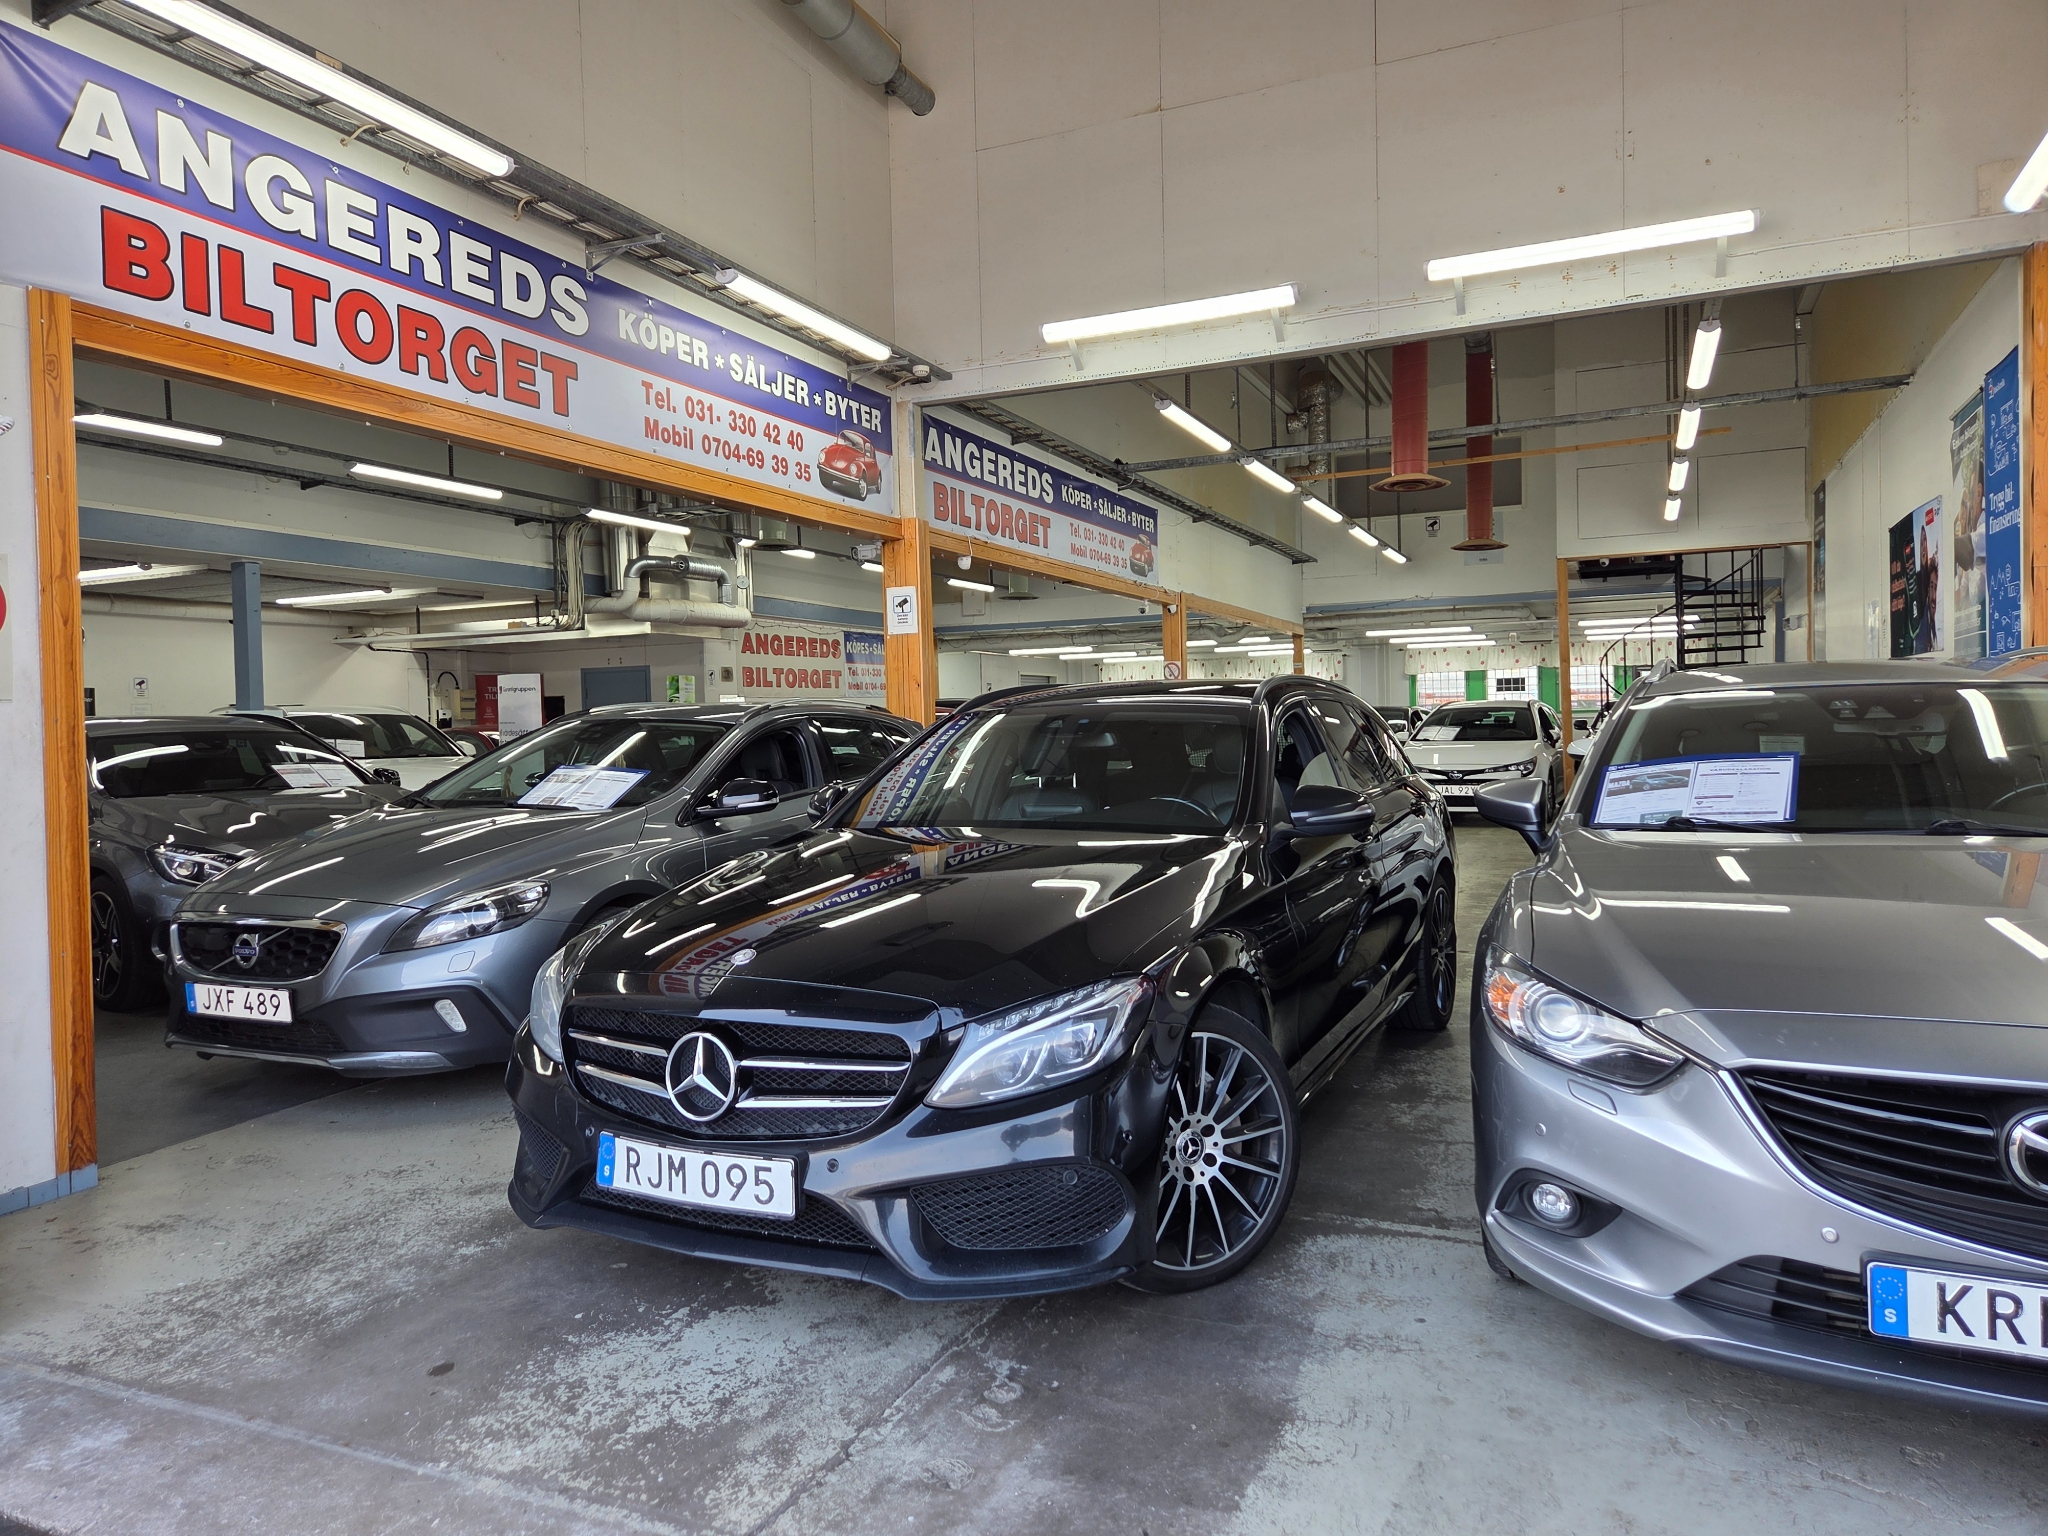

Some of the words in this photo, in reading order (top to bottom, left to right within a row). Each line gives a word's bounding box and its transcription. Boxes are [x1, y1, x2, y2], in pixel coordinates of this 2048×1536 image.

[57, 80, 590, 337] ANGEREDS
[101, 205, 578, 417] BILTORGET
[617, 308, 710, 371] KÖPER
[729, 352, 810, 407] SÄLJER
[824, 390, 883, 434] BYTER
[641, 379, 677, 414] Tel.
[685, 396, 721, 426] 031-
[728, 409, 757, 438] 330
[763, 422, 781, 445] 42
[787, 429, 804, 452] 40
[644, 416, 694, 450] Mobil
[701, 433, 765, 469] 0704-69
[771, 454, 789, 476] 39
[795, 461, 812, 482] 35
[924, 426, 1054, 504] ANGEREDS
[933, 481, 1051, 549] BILTORGET
[1061, 484, 1092, 511] KÖPER
[1098, 497, 1127, 524] SÄLJER
[1131, 512, 1154, 533] BYTER
[1070, 522, 1082, 538] Tel.
[1098, 531, 1108, 547] 330
[1110, 536, 1117, 549] 42
[1118, 538, 1125, 552] 40
[1070, 542, 1087, 558] Mobil
[1089, 548, 1111, 565] 0704-69
[1113, 554, 1119, 567] 39
[1121, 557, 1127, 569] 35
[741, 632, 842, 659] ANGEREDS
[742, 666, 842, 689] BILTORGET
[848, 667, 859, 676] Tel.
[848, 682, 863, 690] Mobil
[203, 987, 234, 1012] JXF
[243, 991, 281, 1017] 489
[604, 1165, 610, 1176] S
[625, 1146, 687, 1194] RJM
[701, 1160, 775, 1205] 095
[1884, 1308, 1897, 1323] S
